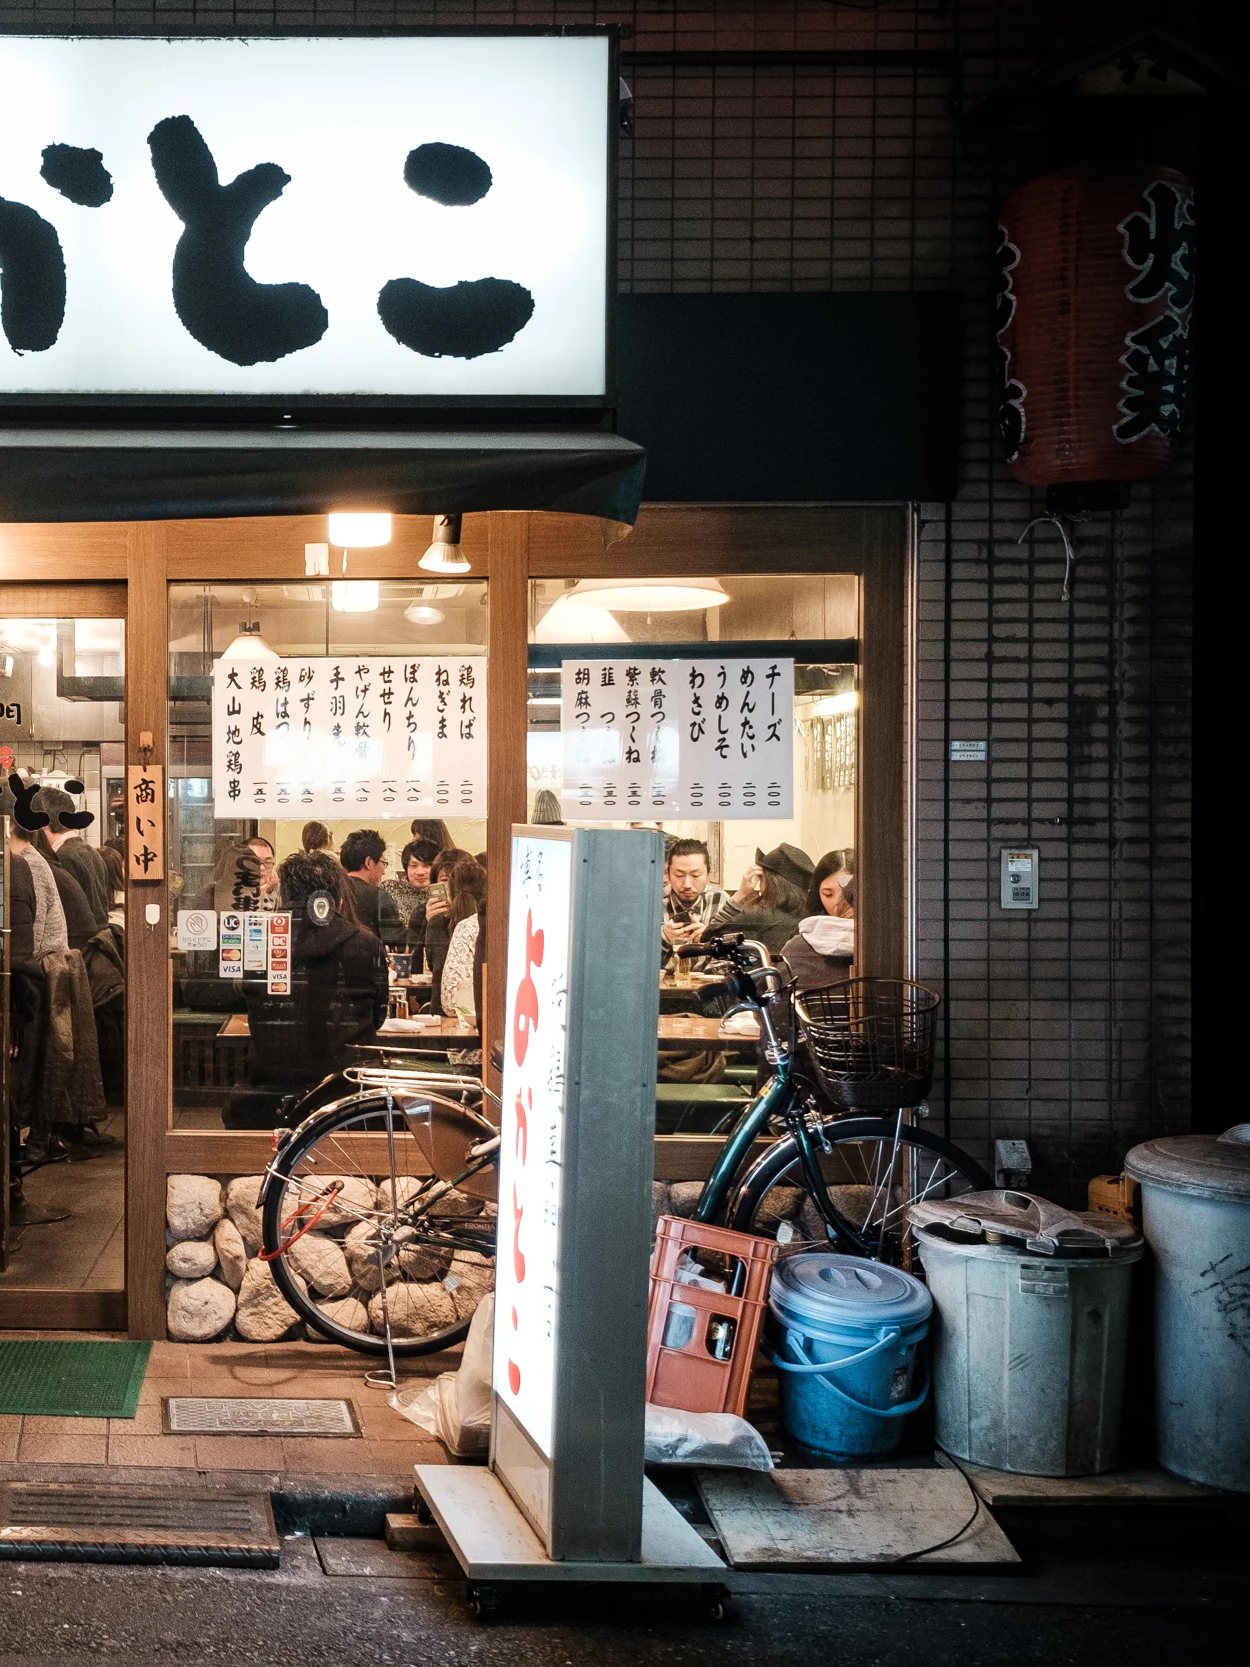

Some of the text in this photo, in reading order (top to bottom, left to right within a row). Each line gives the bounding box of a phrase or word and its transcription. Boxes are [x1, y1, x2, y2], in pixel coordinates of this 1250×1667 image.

[226, 666, 243, 803] 大山地鶏串
[250, 666, 267, 737] 鶏皮
[274, 666, 291, 739] 鶏はつ
[298, 666, 316, 740] 砂ずり
[329, 665, 346, 747] 手羽先
[354, 664, 372, 760] やげん軟骨
[379, 664, 395, 733] せせり
[403, 663, 421, 761] ぼんちり
[435, 664, 451, 740] ねぎま
[458, 664, 476, 740] 鶏れば
[625, 666, 642, 764] 紫蘇つくね
[689, 665, 706, 743] わさび
[714, 665, 730, 760] うめしそ
[739, 665, 756, 759] めんたい
[765, 664, 782, 742] チーズ
[133, 777, 158, 875] 商い中
[224, 917, 240, 928] UC
[223, 965, 241, 973] VISA
